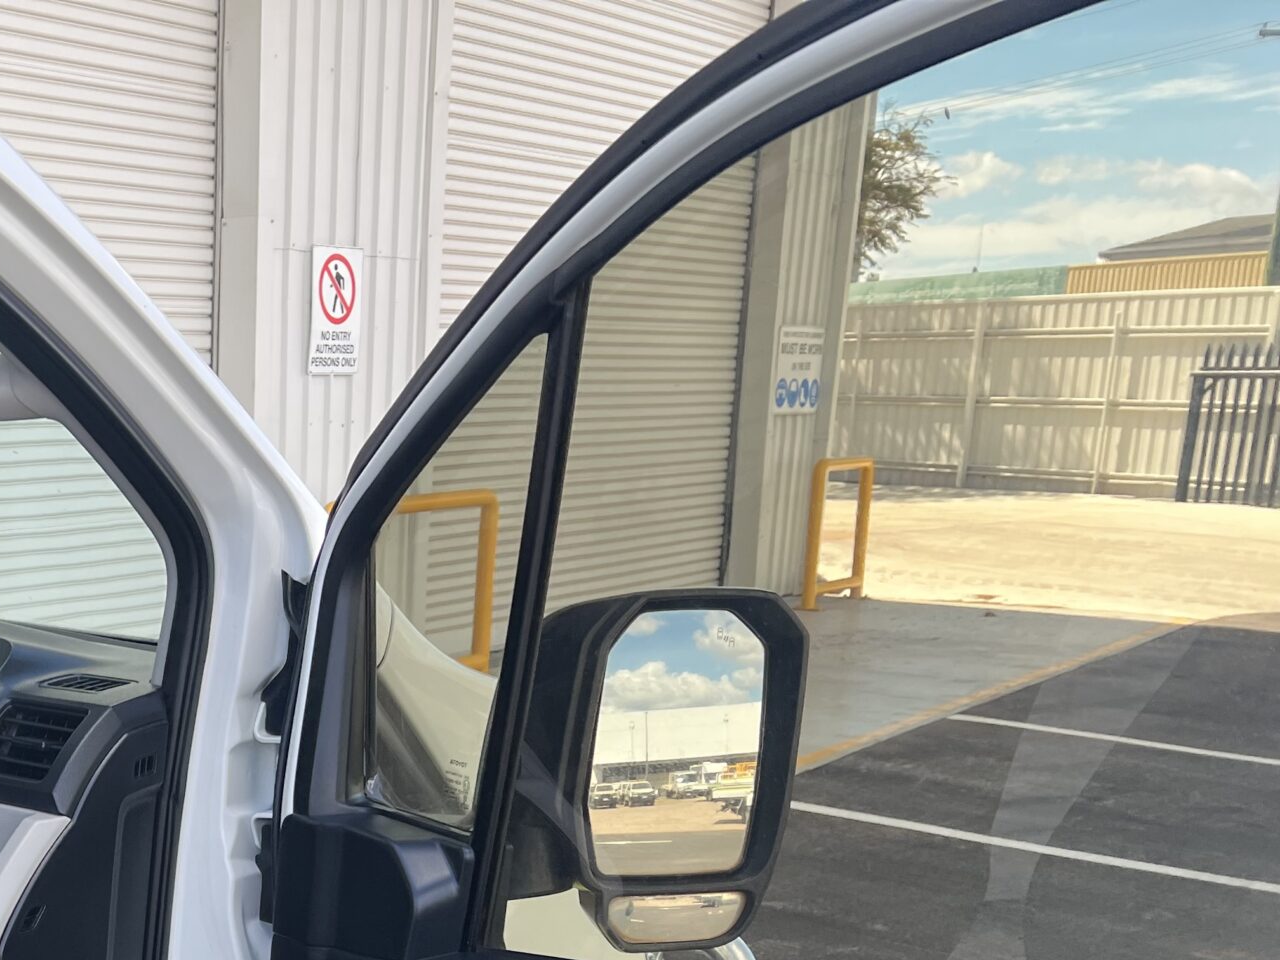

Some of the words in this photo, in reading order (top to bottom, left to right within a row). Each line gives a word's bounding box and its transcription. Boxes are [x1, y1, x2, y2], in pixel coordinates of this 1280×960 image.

[320, 331, 330, 341] NO
[331, 331, 352, 341] ENTRY
[315, 344, 354, 354] AUTHORISED
[311, 357, 340, 367] PERSONS
[341, 357, 357, 367] ONLY
